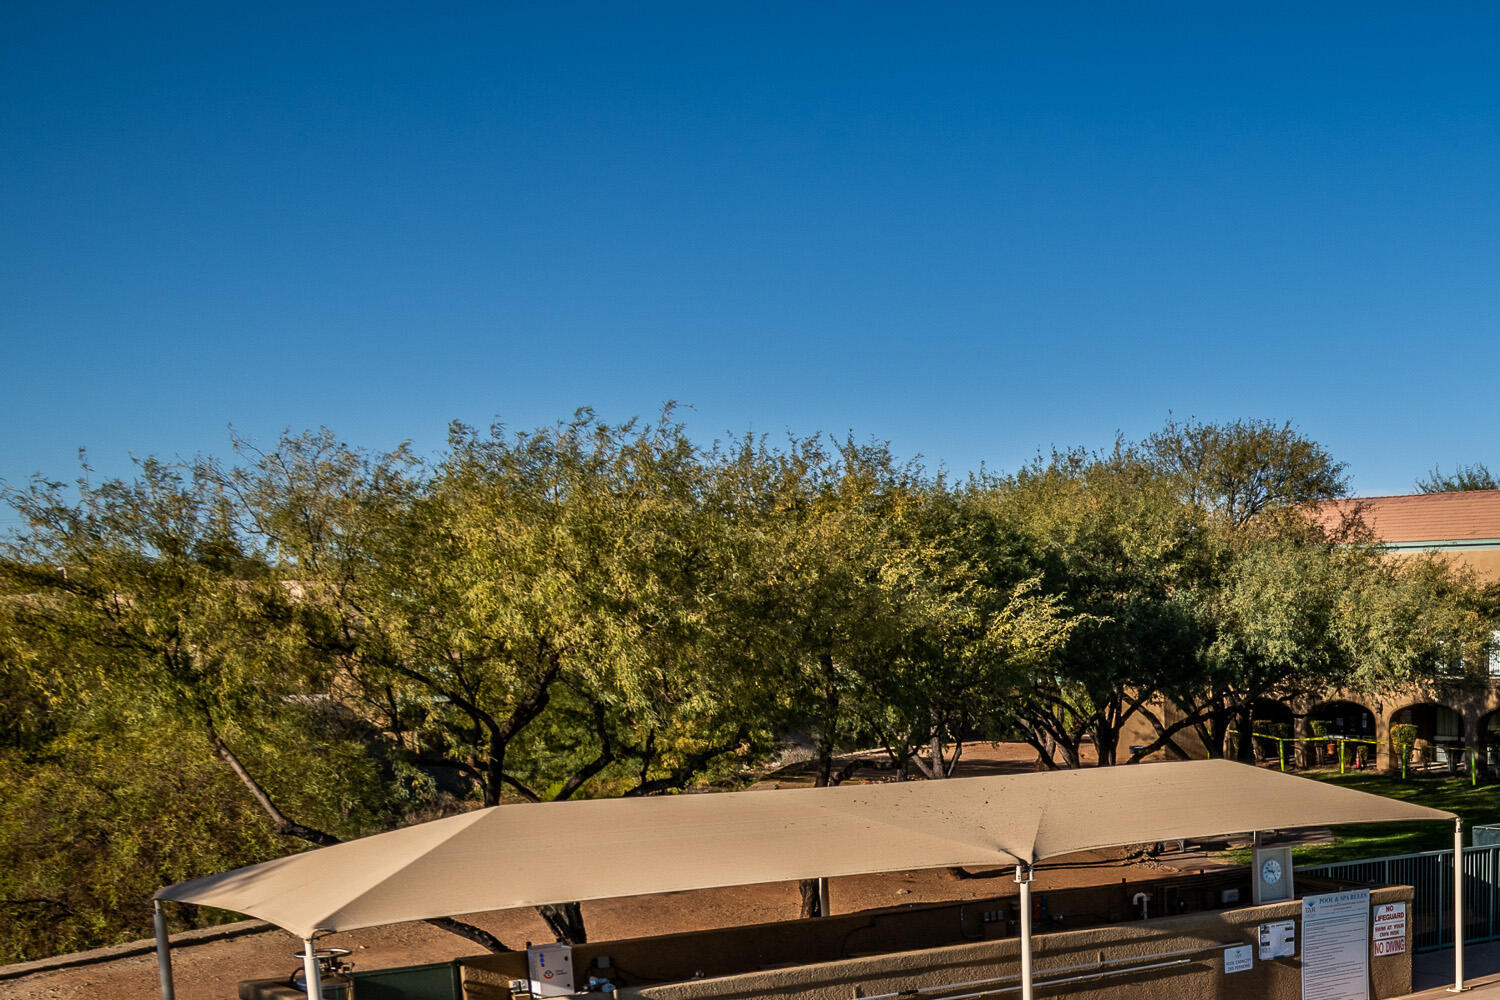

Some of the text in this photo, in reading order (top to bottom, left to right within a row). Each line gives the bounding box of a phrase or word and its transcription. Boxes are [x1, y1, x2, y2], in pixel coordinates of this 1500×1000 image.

[1375, 912, 1404, 922] LIFEGUARD
[1374, 939, 1404, 955] NO DIVING
